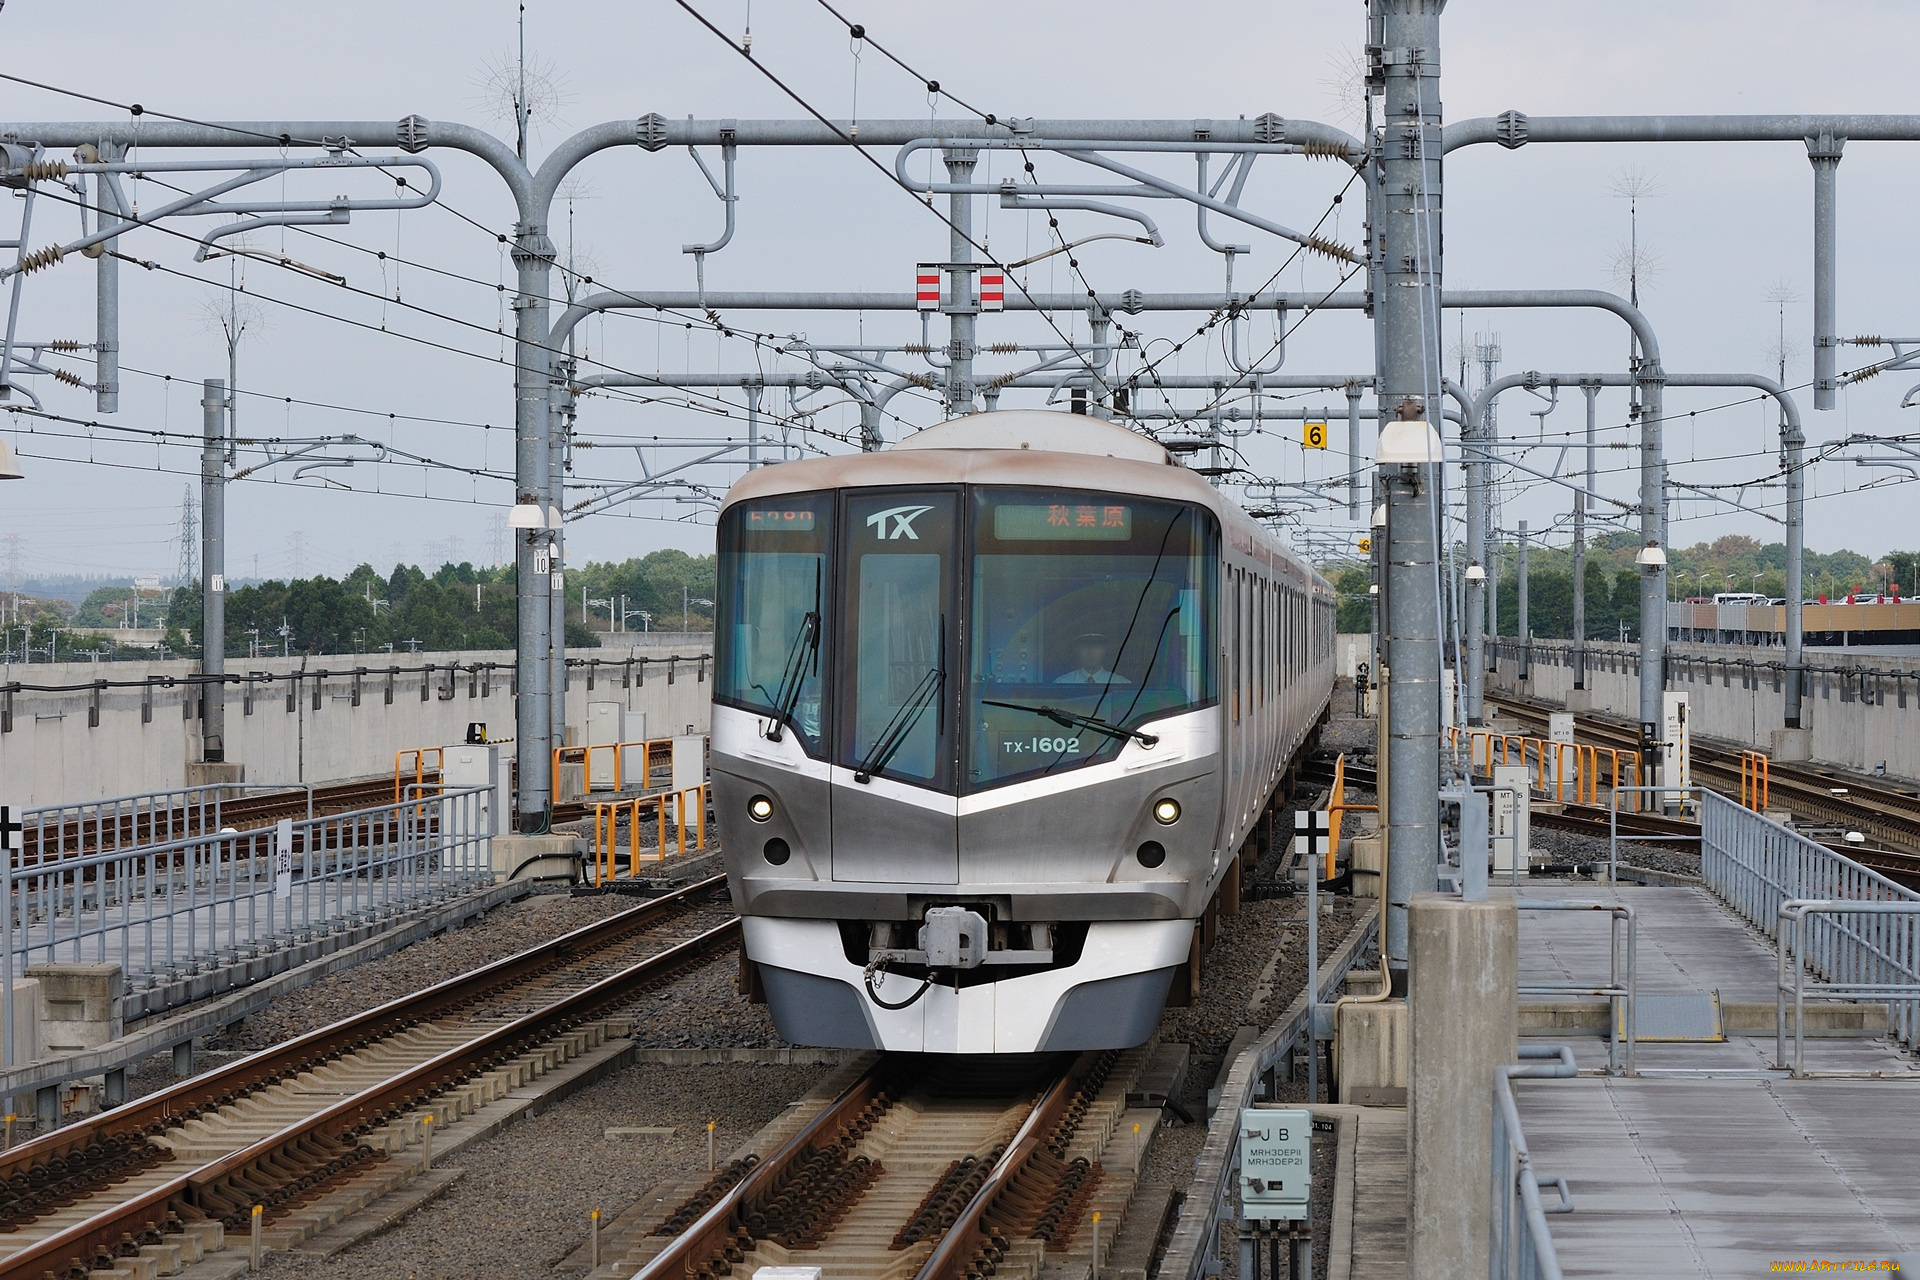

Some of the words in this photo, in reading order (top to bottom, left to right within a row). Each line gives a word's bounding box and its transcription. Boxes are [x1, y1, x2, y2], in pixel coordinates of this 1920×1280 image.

[1309, 426, 1322, 446] 6
[866, 505, 936, 540] TX
[1047, 504, 1125, 528] 秋葉原
[1003, 737, 1080, 753] TX-1602
